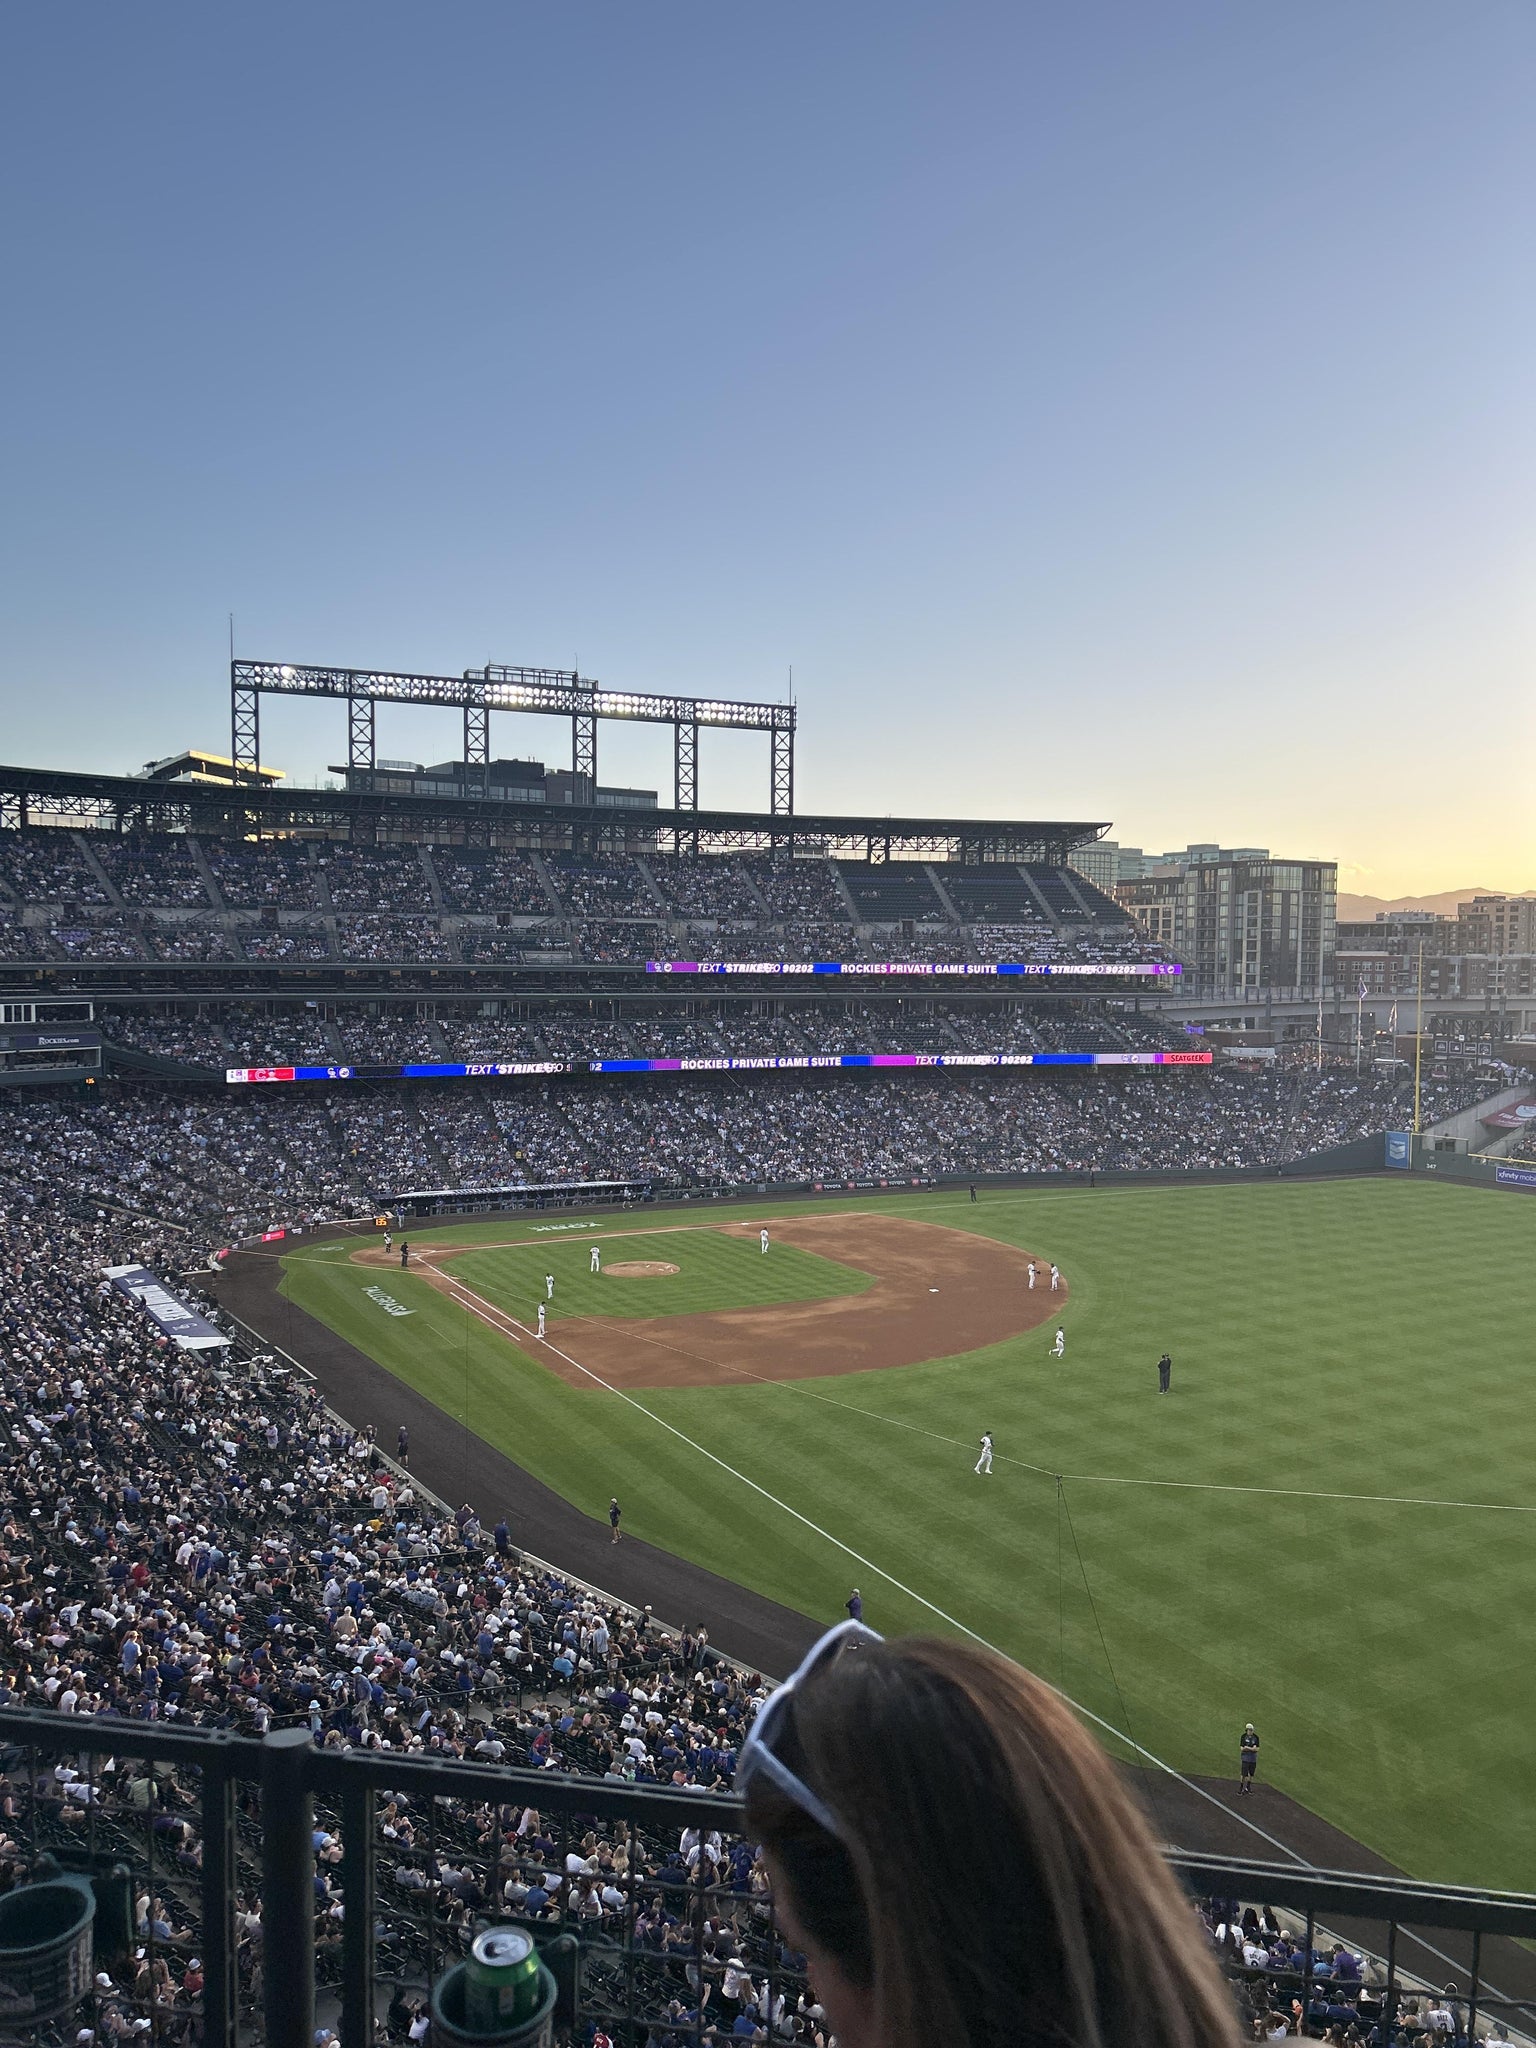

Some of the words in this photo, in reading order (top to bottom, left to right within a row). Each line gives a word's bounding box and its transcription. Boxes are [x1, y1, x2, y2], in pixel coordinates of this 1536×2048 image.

[697, 963, 721, 973] TEXT
[782, 964, 814, 973] 90202
[840, 964, 887, 974] ROCKIES
[889, 964, 933, 974] PRIVATE
[934, 965, 966, 974] GAME
[966, 965, 998, 974] SUITE
[1023, 965, 1047, 974] TEXT
[1105, 965, 1137, 974] 90202
[915, 1056, 938, 1065] TEXT
[1000, 1056, 1033, 1065] 90202
[1170, 1054, 1205, 1062] SEATGEEK
[681, 1059, 730, 1070] ROCKIES
[732, 1058, 777, 1069] PRIVATE
[778, 1058, 809, 1068] GAME
[811, 1057, 842, 1067] SUITE
[465, 1064, 493, 1075] TEXT
[823, 1183, 842, 1191] TOYOTA
